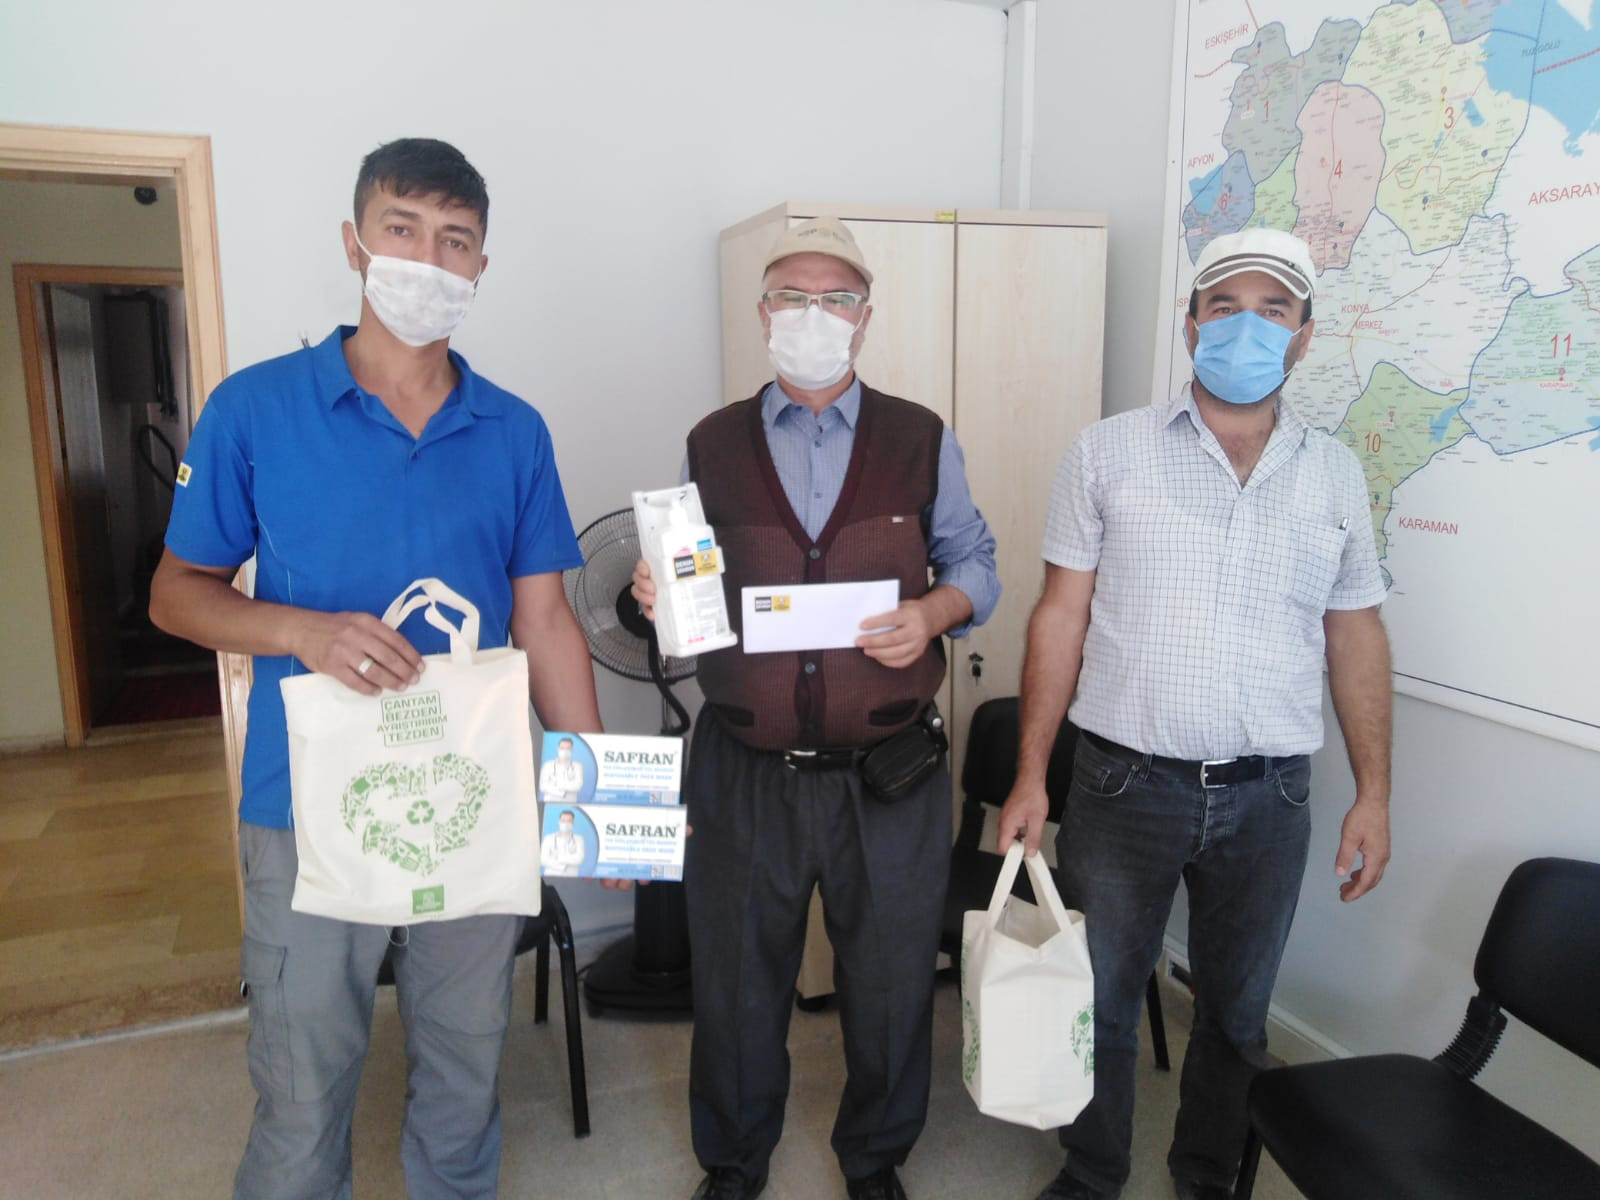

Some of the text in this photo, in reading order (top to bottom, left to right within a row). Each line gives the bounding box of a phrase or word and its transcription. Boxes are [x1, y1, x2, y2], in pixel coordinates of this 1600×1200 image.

[1204, 23, 1249, 49] ESKİŞEHİR
[1443, 106, 1455, 129] 3
[1187, 153, 1215, 168] AFYON
[1333, 159, 1343, 178] 4
[1528, 182, 1600, 206] AKSARAY
[1341, 304, 1370, 314] KONYA
[1355, 320, 1383, 330] MERKEZ
[1550, 332, 1572, 358] 11
[1363, 433, 1382, 453] 10
[1398, 517, 1459, 535] KARAMAN
[385, 706, 438, 722] BEZDEN
[388, 726, 440, 742] TEZDEN
[604, 751, 674, 765] SAFRAN
[605, 823, 677, 838] SAFRAN
